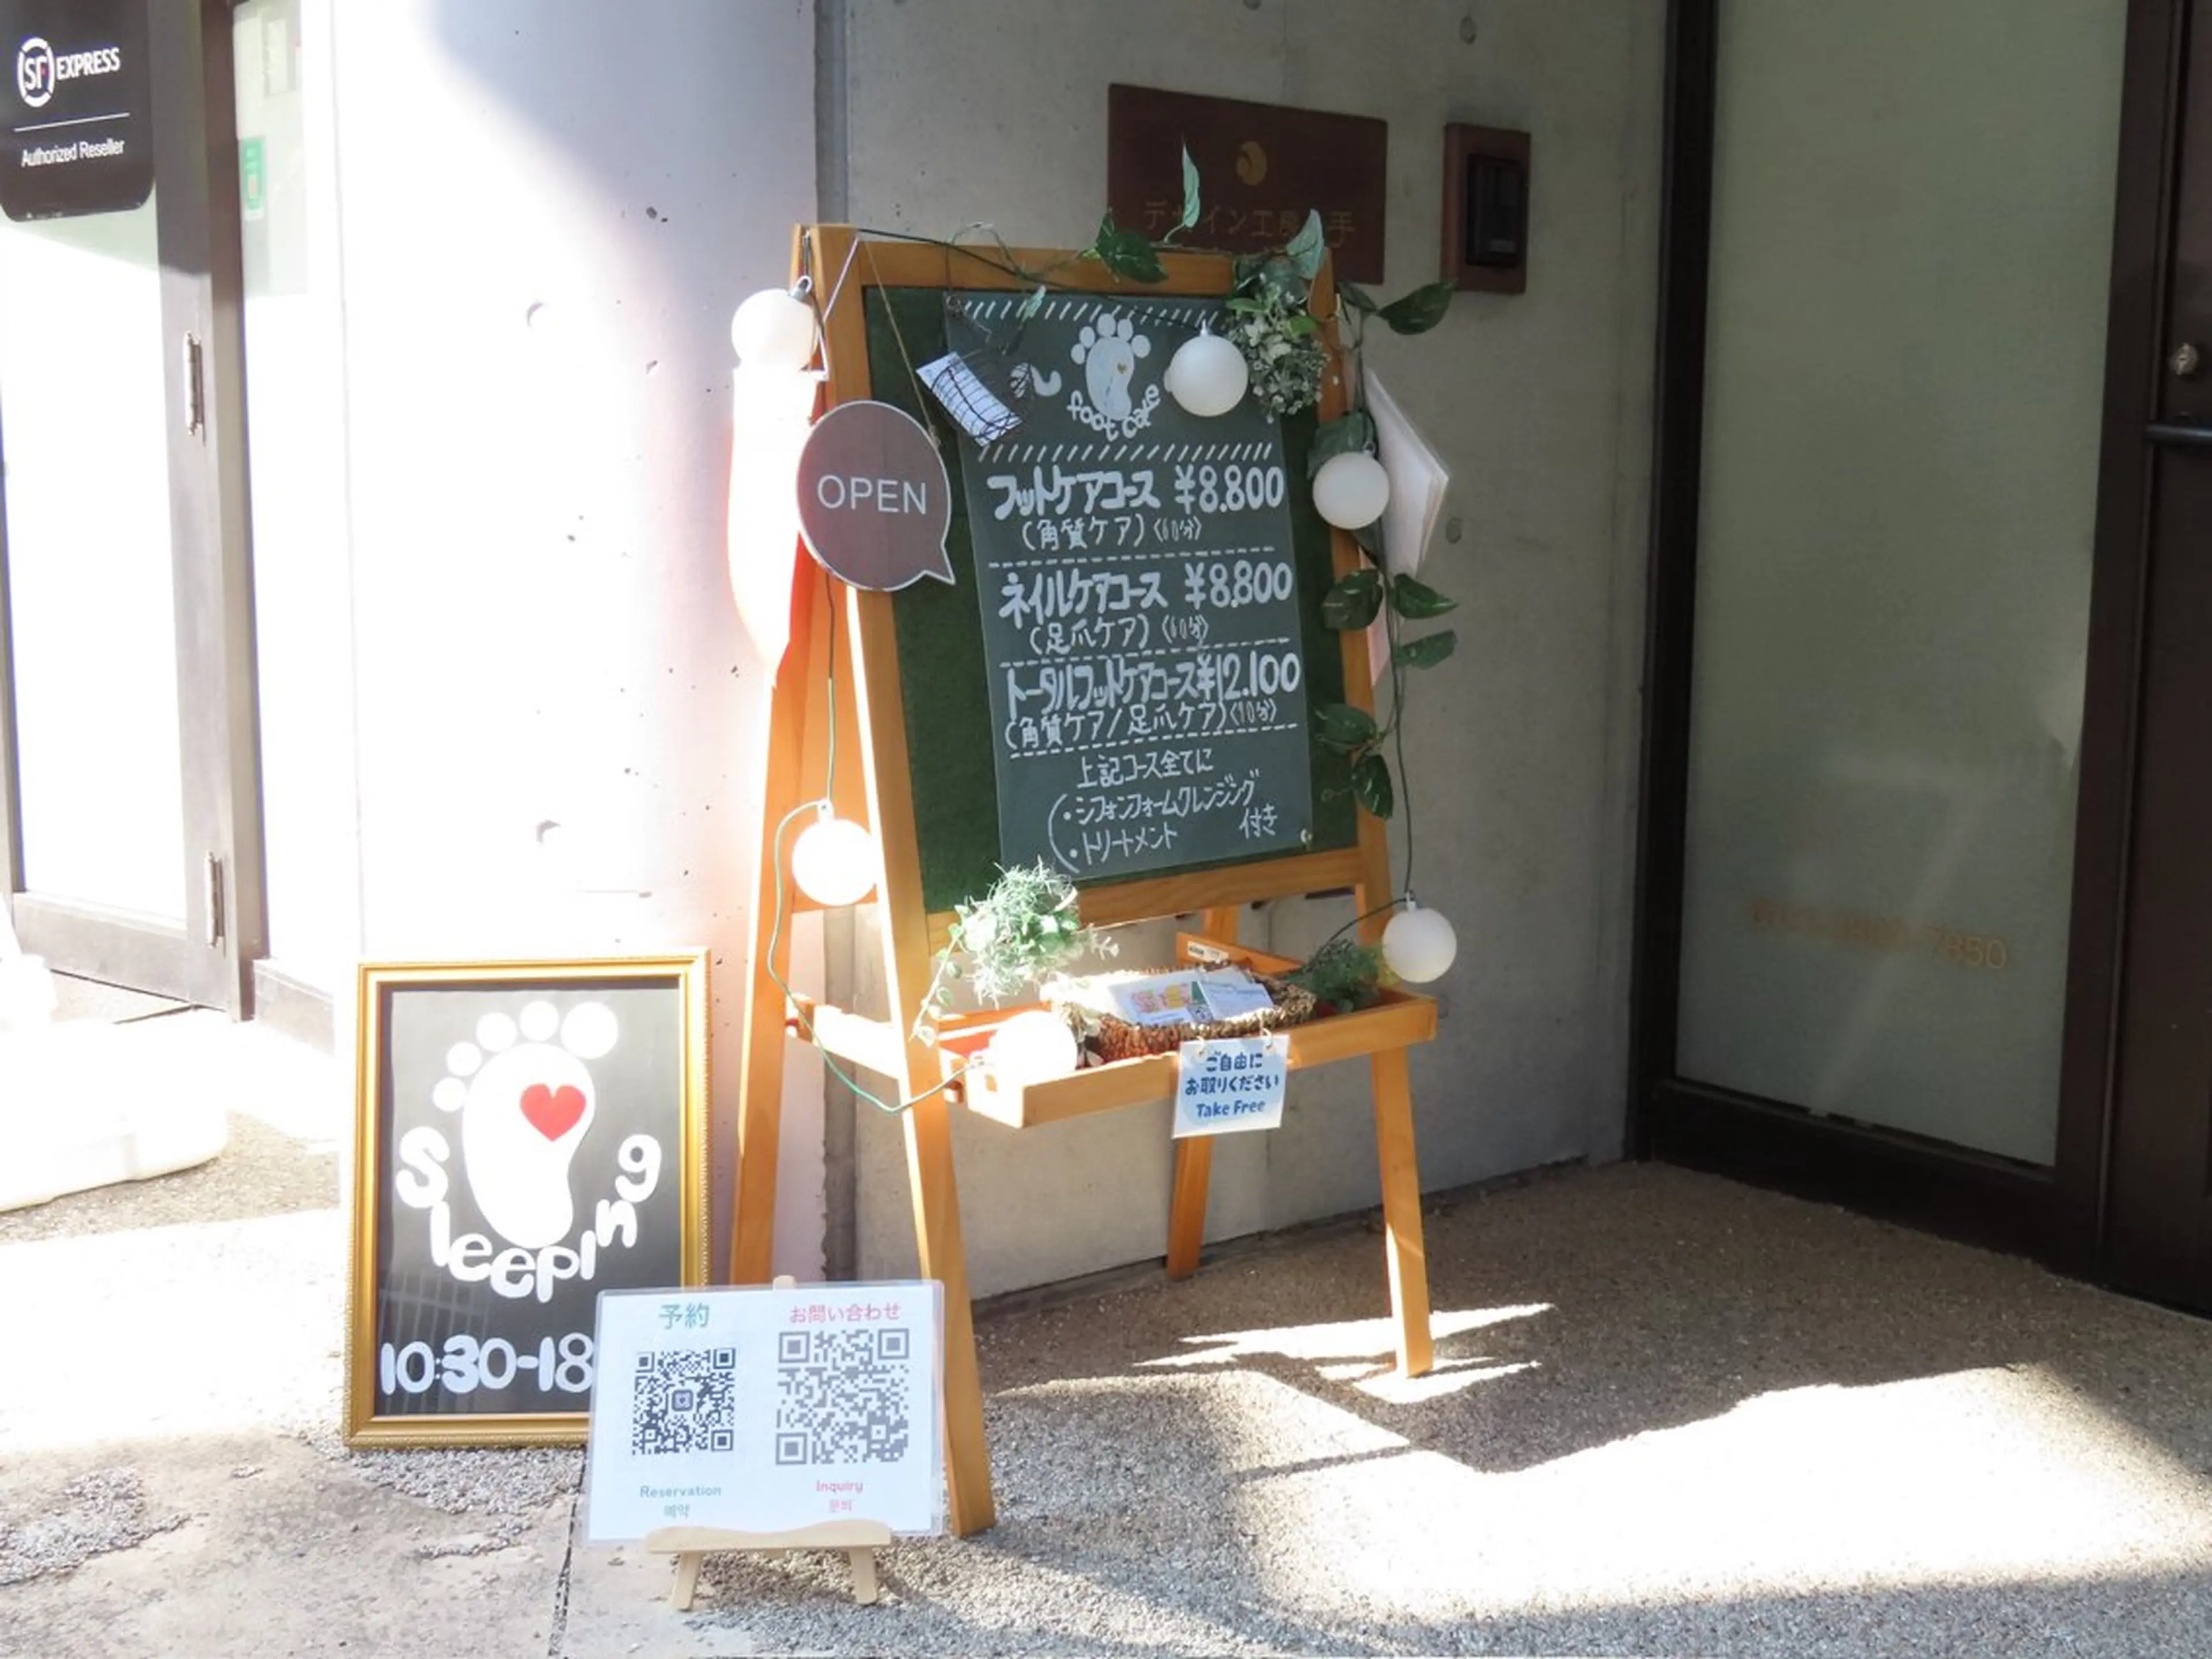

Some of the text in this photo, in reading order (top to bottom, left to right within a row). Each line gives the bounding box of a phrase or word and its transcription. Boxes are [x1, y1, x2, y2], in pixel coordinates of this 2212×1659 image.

[56, 48, 120, 80] EXPRESS
[22, 138, 124, 167] Authorized Reseller
[817, 474, 926, 515] OPEN
[987, 465, 1161, 520] フットケアコース
[998, 567, 1168, 630] ネイルケアコース
[1076, 748, 1214, 789] 上記コース全てに
[1238, 802, 1279, 839] 付き
[1206, 1051, 1263, 1072] ご自由に
[1185, 1075, 1278, 1095] お取りください
[1196, 1099, 1266, 1118] Take Free
[658, 1302, 711, 1330] 予約
[789, 1302, 902, 1325] お問い合わせ
[639, 1484, 722, 1499] Reservation
[816, 1479, 864, 1494] Inquiry
